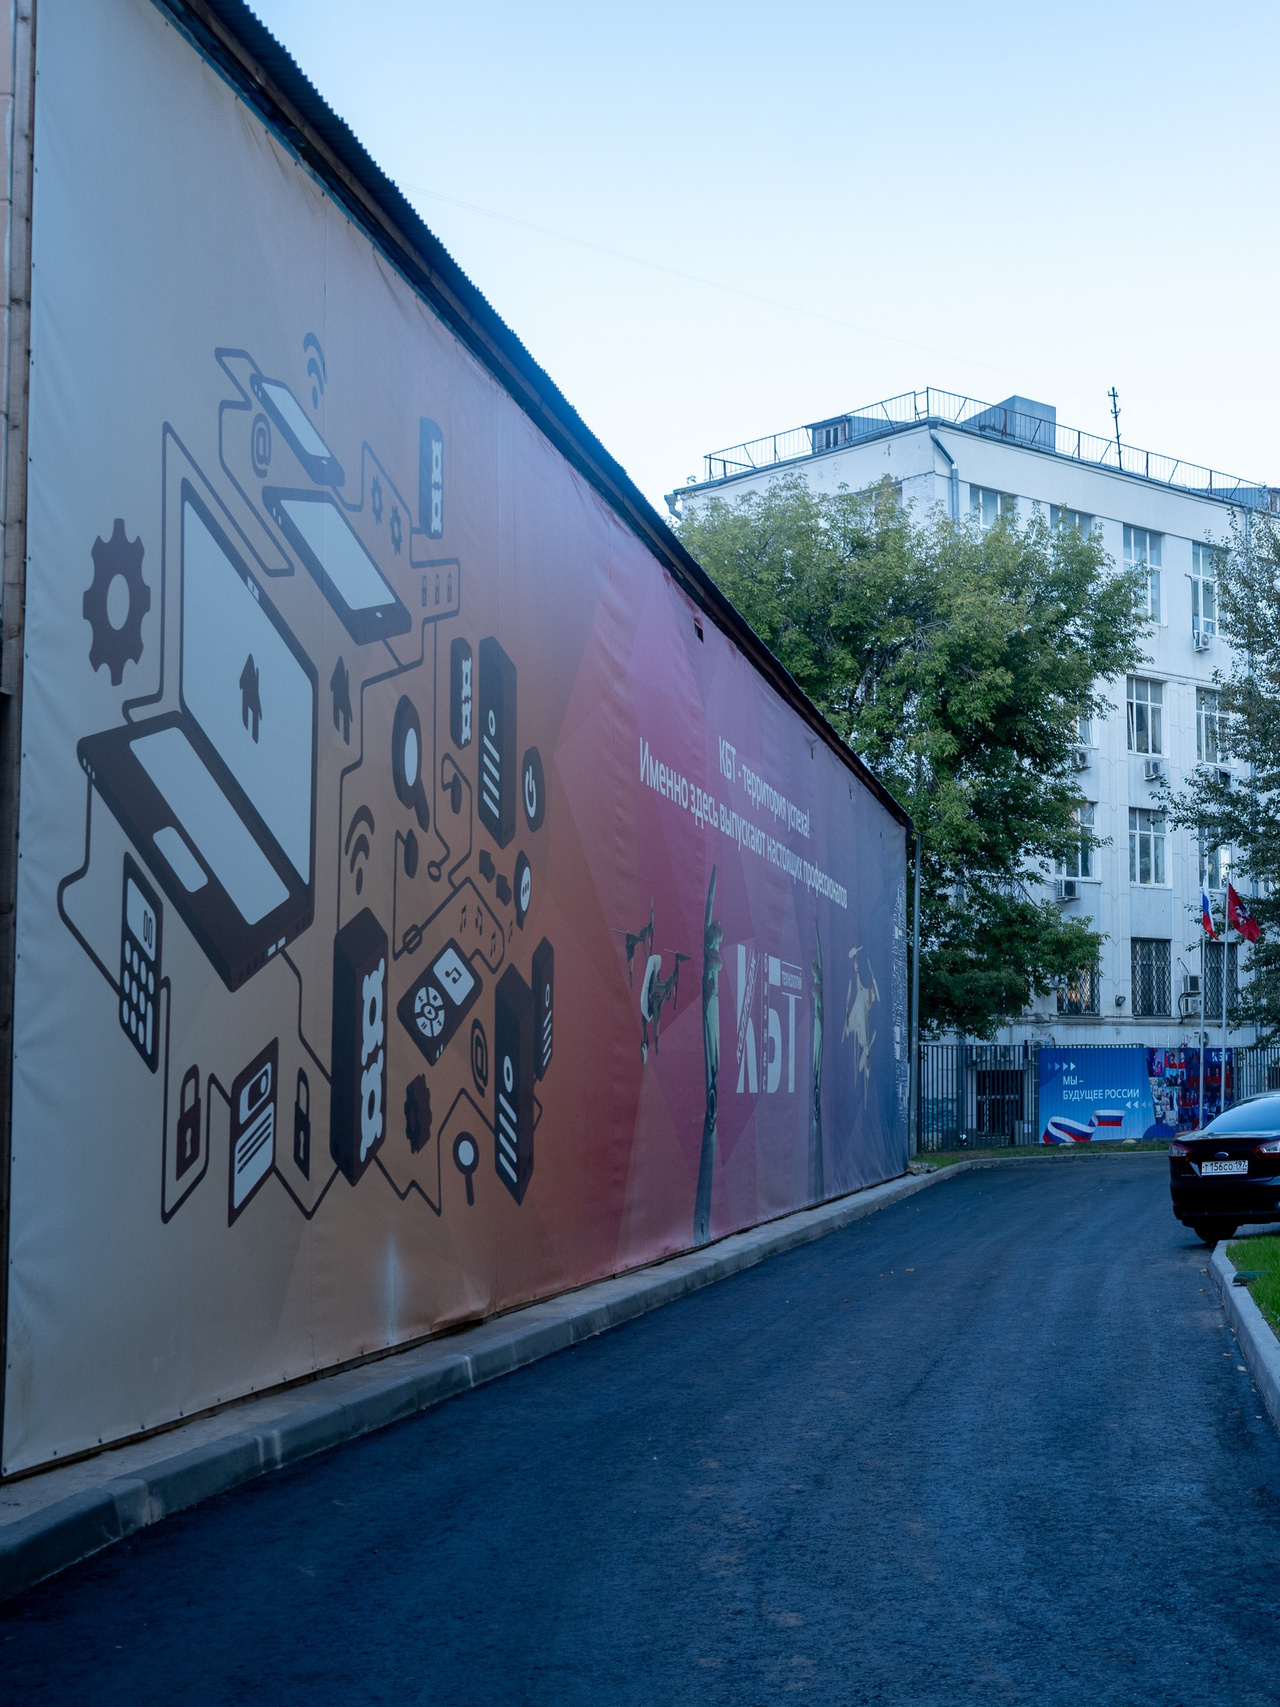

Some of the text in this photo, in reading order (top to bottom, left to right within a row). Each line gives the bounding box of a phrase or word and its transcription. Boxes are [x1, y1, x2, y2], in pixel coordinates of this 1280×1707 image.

[719, 736, 737, 784] КБТ
[742, 764, 787, 823] территория
[786, 800, 810, 840] успеха!
[639, 736, 848, 910] Именно здесь выпускают настоящих профессионалов
[1062, 1075, 1078, 1086] МЫ
[1062, 1088, 1140, 1102] БУДУЩЕЕ РОССИИ
[1234, 1160, 1246, 1168] 197
